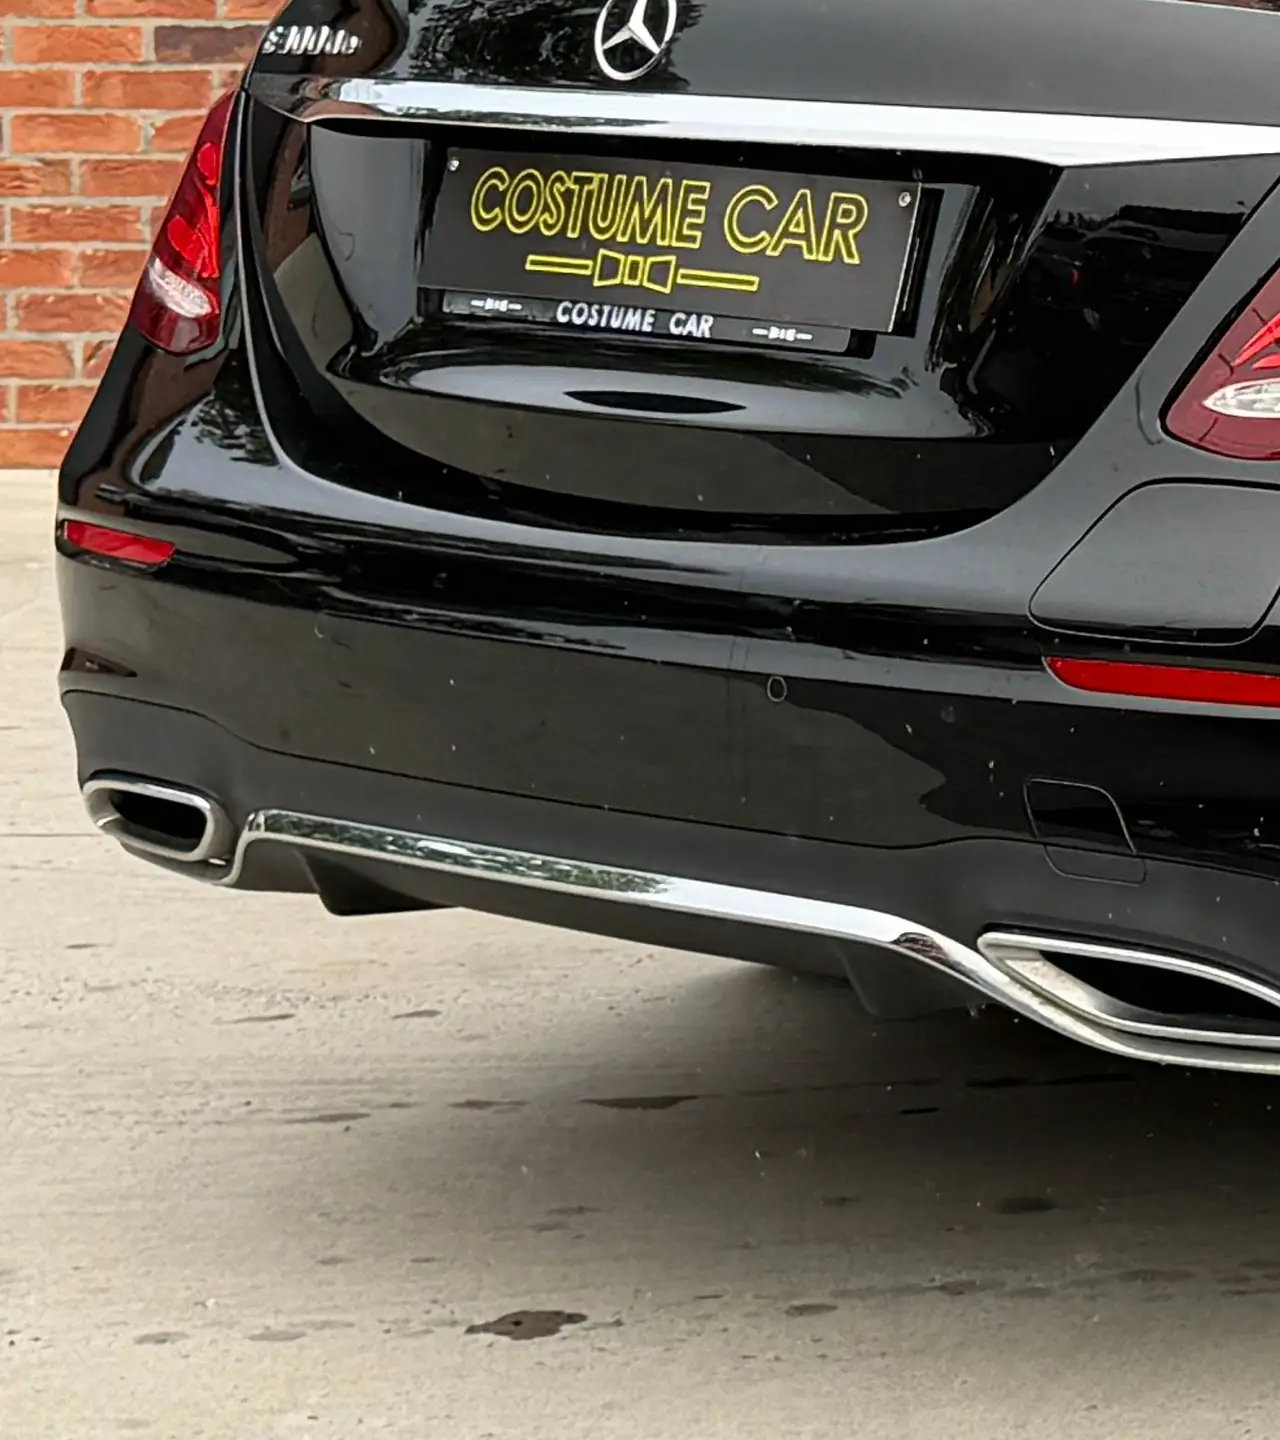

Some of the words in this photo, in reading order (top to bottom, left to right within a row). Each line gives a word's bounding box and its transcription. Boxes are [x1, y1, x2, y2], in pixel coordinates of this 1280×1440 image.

[470, 166, 711, 249] COSTUME
[723, 185, 868, 265] CAR
[556, 301, 656, 333] COSTUME
[668, 311, 715, 339] CAR
